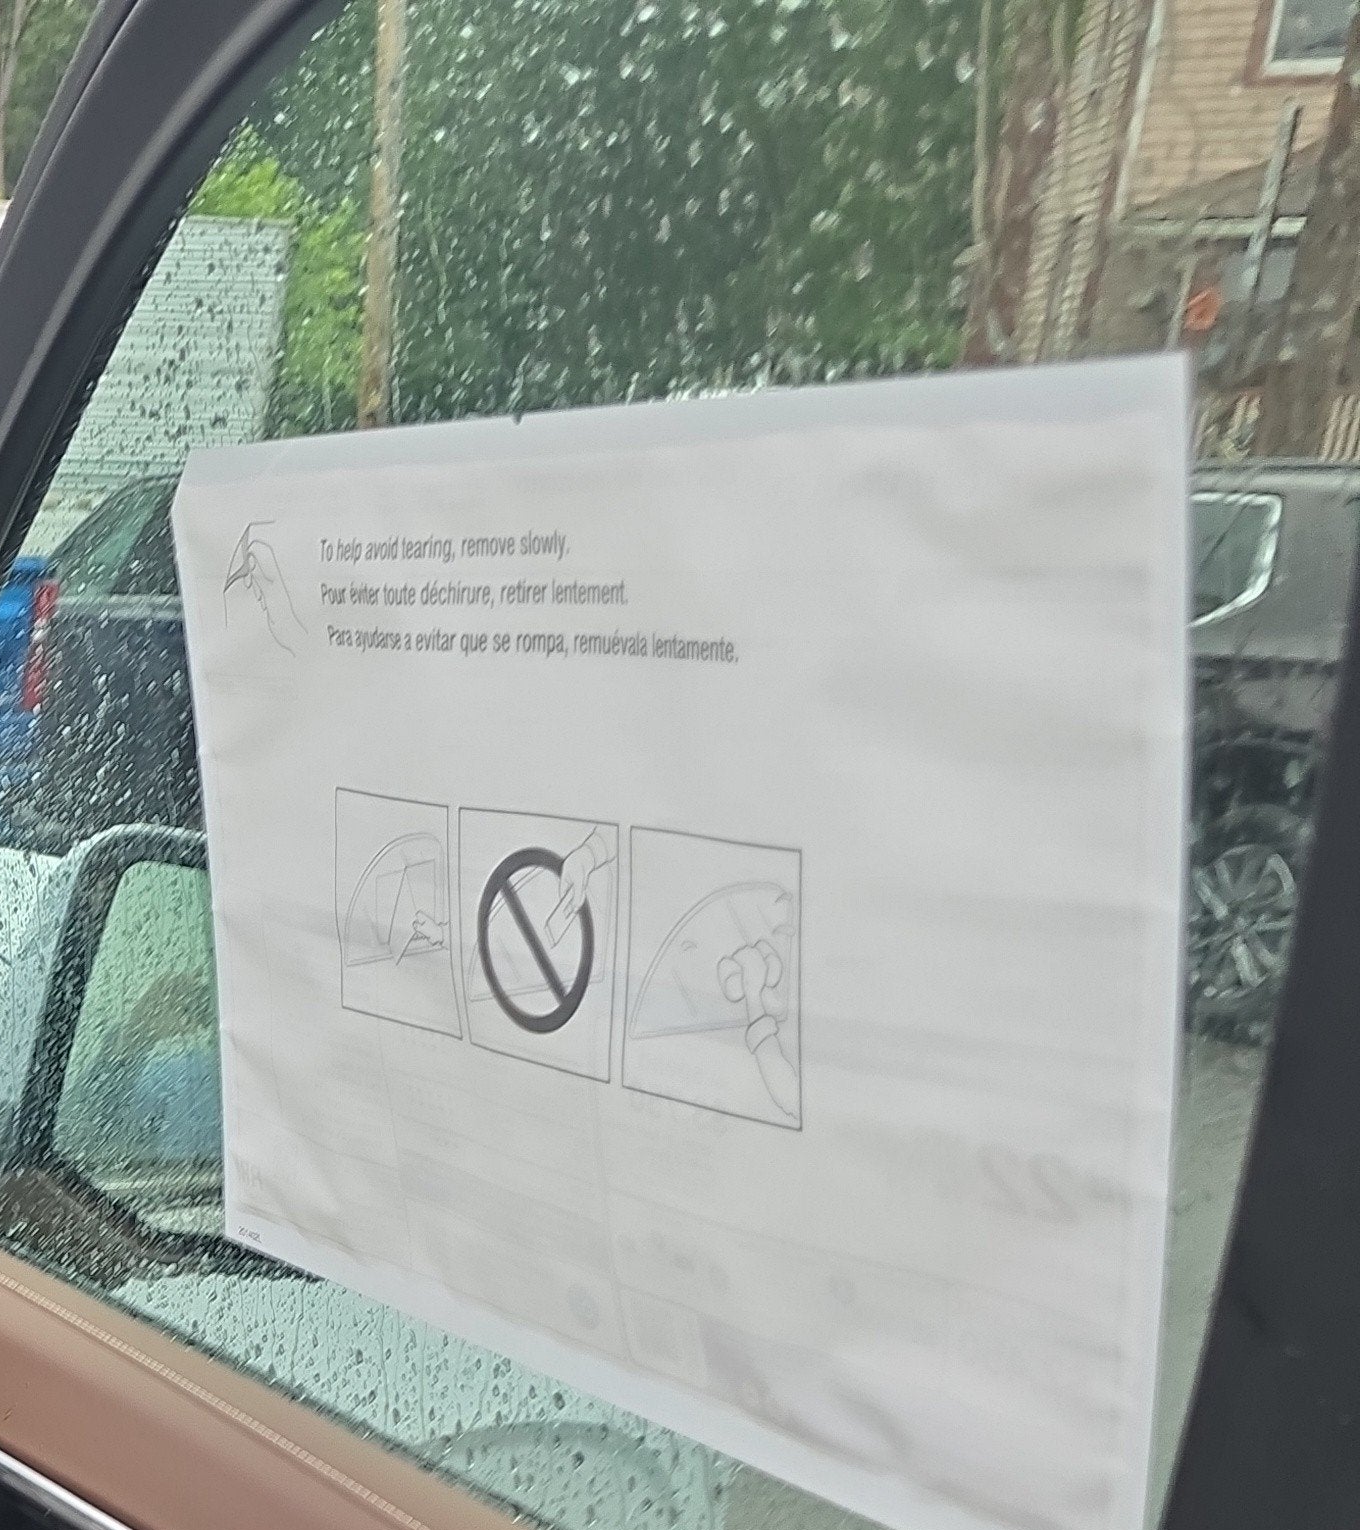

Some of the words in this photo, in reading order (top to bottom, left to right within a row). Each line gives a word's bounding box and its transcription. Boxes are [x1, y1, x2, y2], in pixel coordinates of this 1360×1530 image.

[319, 537, 333, 562] To
[336, 536, 363, 565] help
[365, 533, 399, 561] avoid
[401, 532, 456, 563] tearing,
[461, 534, 516, 558] remove
[321, 581, 346, 605] Pour
[349, 580, 380, 606] éviter
[383, 581, 416, 606] toute
[420, 578, 496, 609] déchirure,
[500, 577, 548, 605] retirer
[550, 577, 629, 606] lentement.
[327, 624, 353, 648] Para
[355, 625, 401, 654] ayudarse
[404, 634, 412, 651] a
[415, 627, 456, 651] evitar
[460, 632, 488, 658] que
[493, 633, 511, 654] se
[516, 632, 569, 659] rompa,
[574, 629, 648, 657] remuévala
